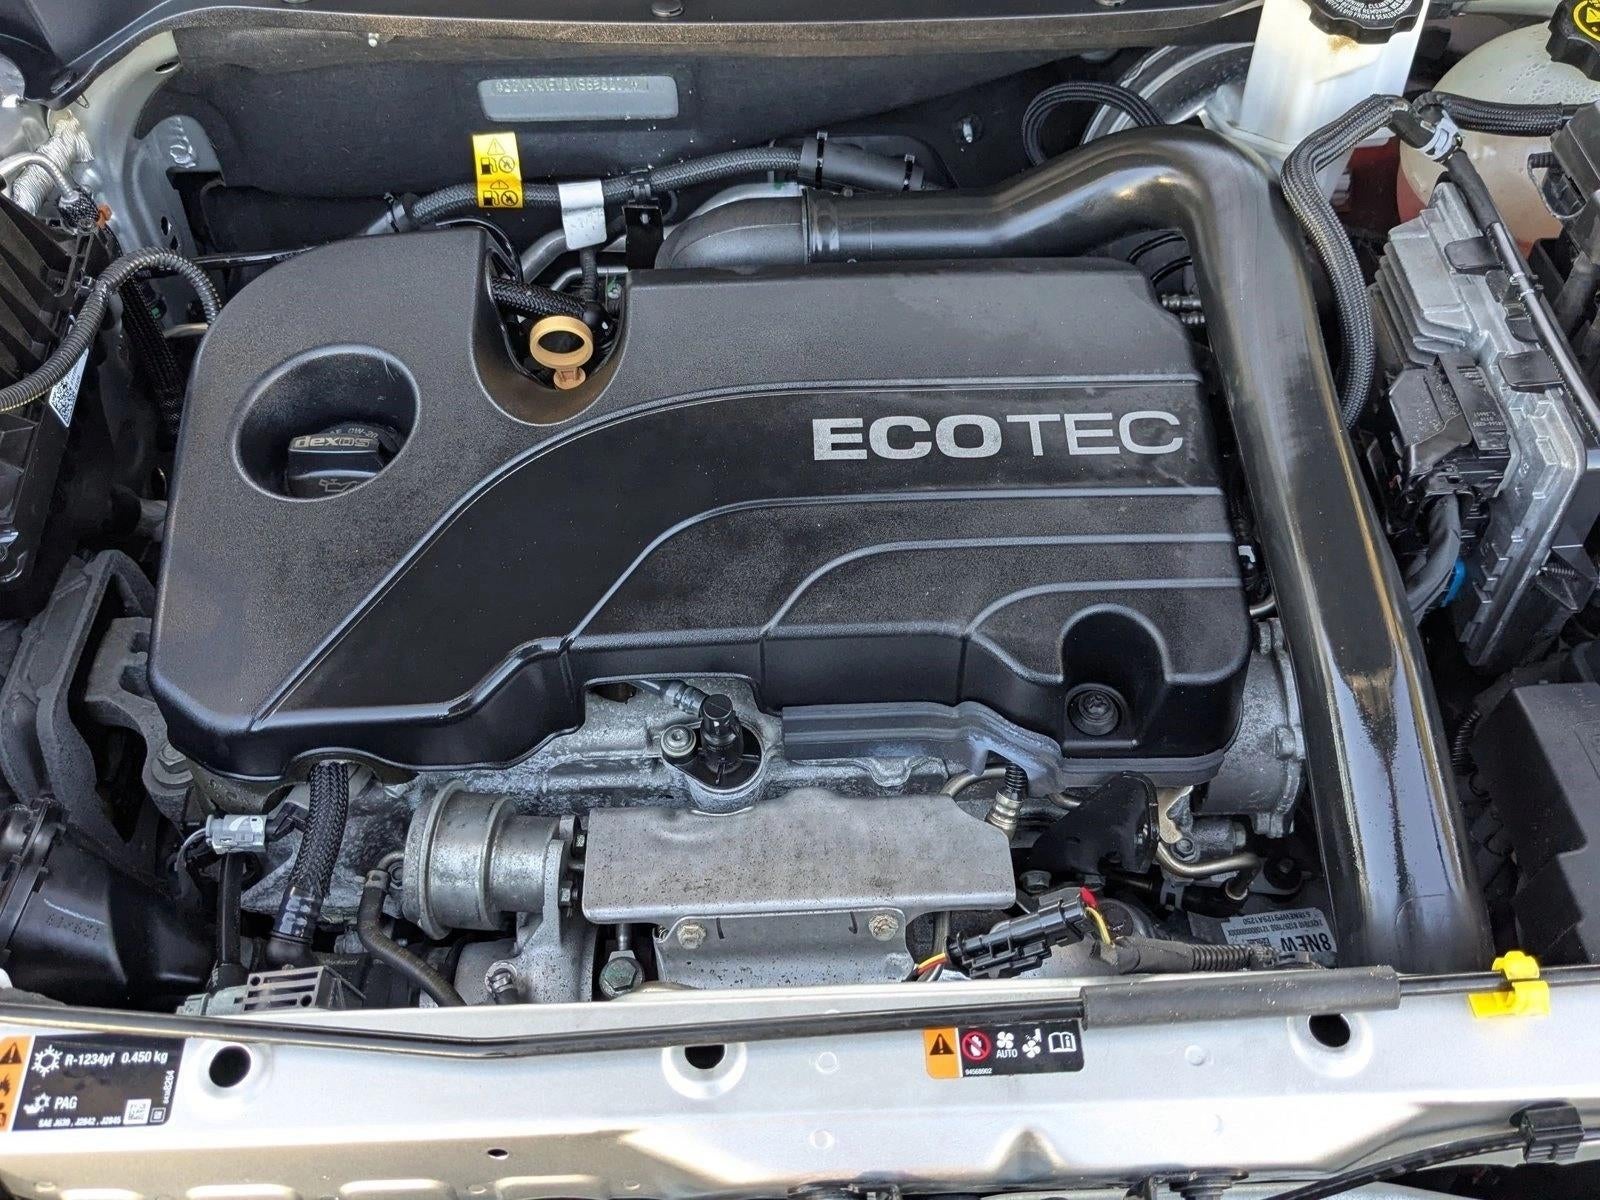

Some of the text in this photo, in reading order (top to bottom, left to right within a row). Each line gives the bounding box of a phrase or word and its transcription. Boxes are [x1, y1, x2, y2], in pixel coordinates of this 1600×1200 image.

[294, 435, 370, 448] dexos
[812, 411, 1184, 460] ECOTEC
[1280, 932, 1332, 953] 8NEW
[64, 1050, 168, 1067] R-1234yf 0.450 kg
[996, 1049, 1018, 1058] AUTO
[54, 1096, 78, 1110] PAG
